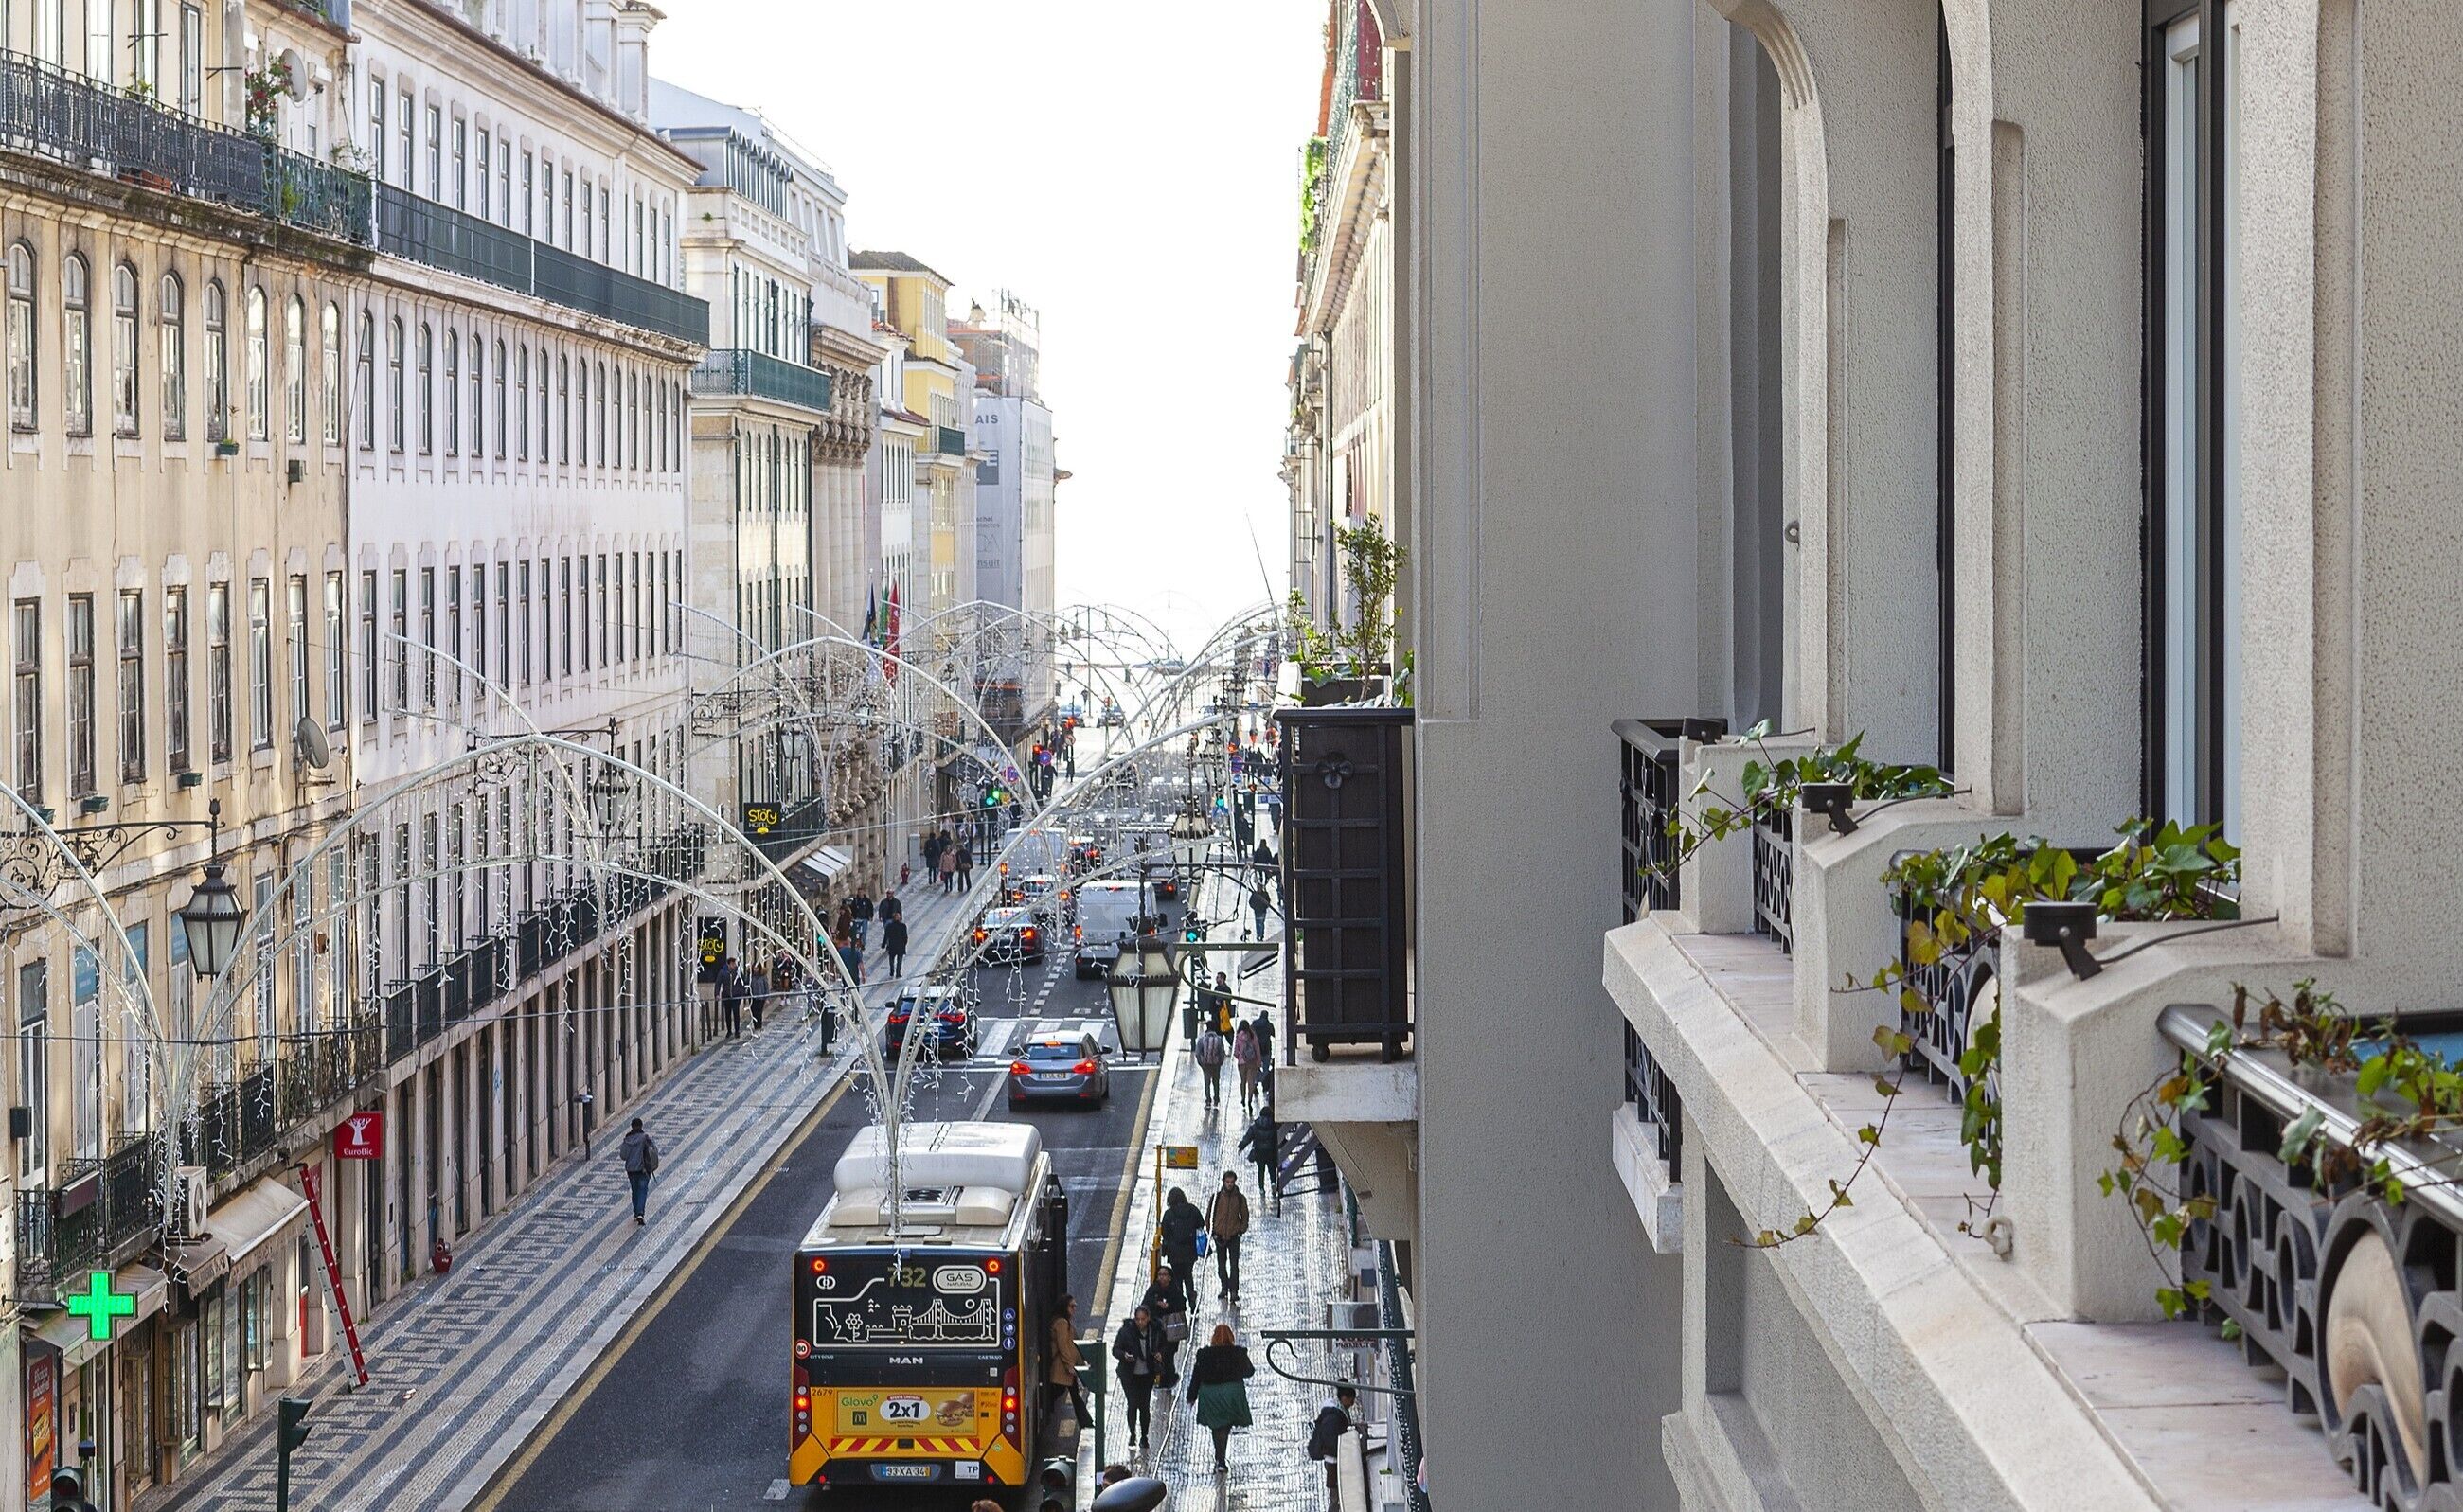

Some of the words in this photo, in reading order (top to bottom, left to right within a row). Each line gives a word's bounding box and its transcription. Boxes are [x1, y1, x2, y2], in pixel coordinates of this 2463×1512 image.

[343, 1147, 373, 1156] EuroBic
[887, 1267, 927, 1288] 732
[946, 1272, 973, 1282] GÁS
[841, 1396, 873, 1406] Glovo
[888, 1401, 920, 1418] 2x1
[967, 1466, 979, 1474] TP
